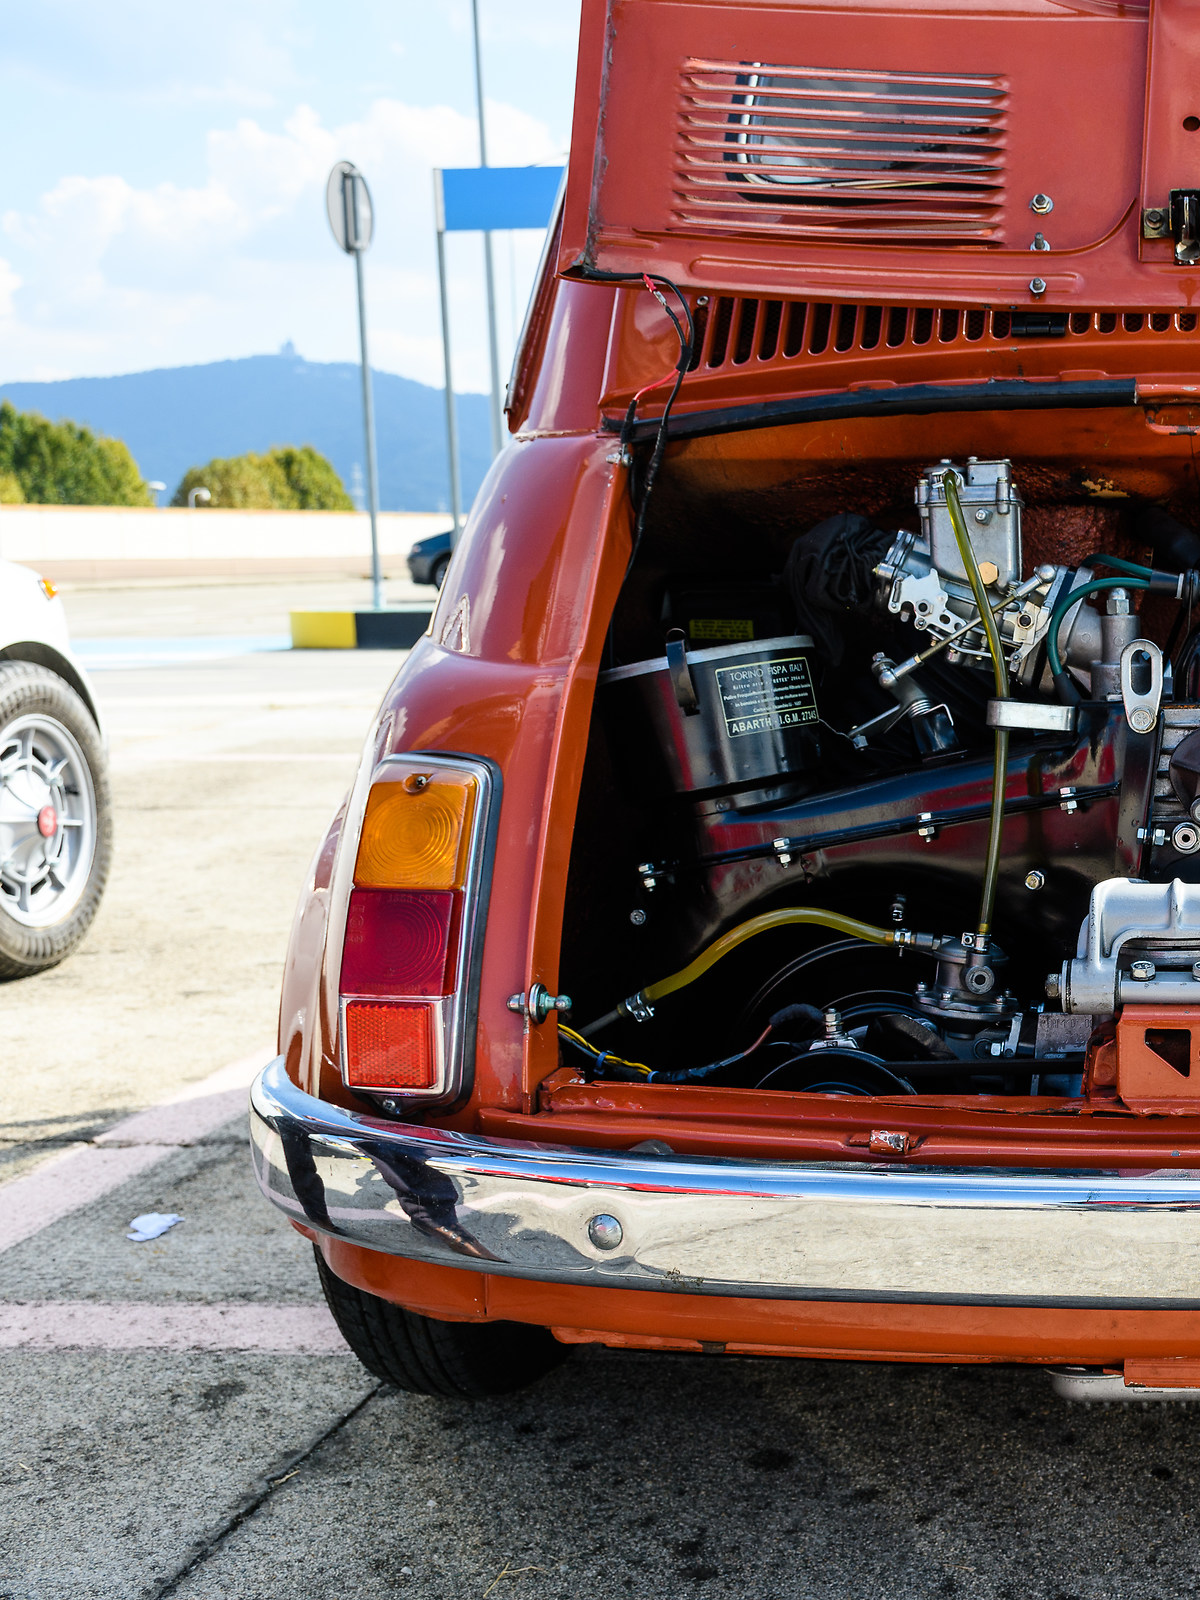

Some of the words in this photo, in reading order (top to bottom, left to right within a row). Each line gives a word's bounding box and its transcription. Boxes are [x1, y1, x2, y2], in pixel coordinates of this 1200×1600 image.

[730, 669, 764, 681] TORINO
[768, 665, 788, 676] FISPA
[788, 663, 803, 672] ITALY
[732, 717, 772, 733] ABARTH
[778, 712, 801, 725] I.G.M.
